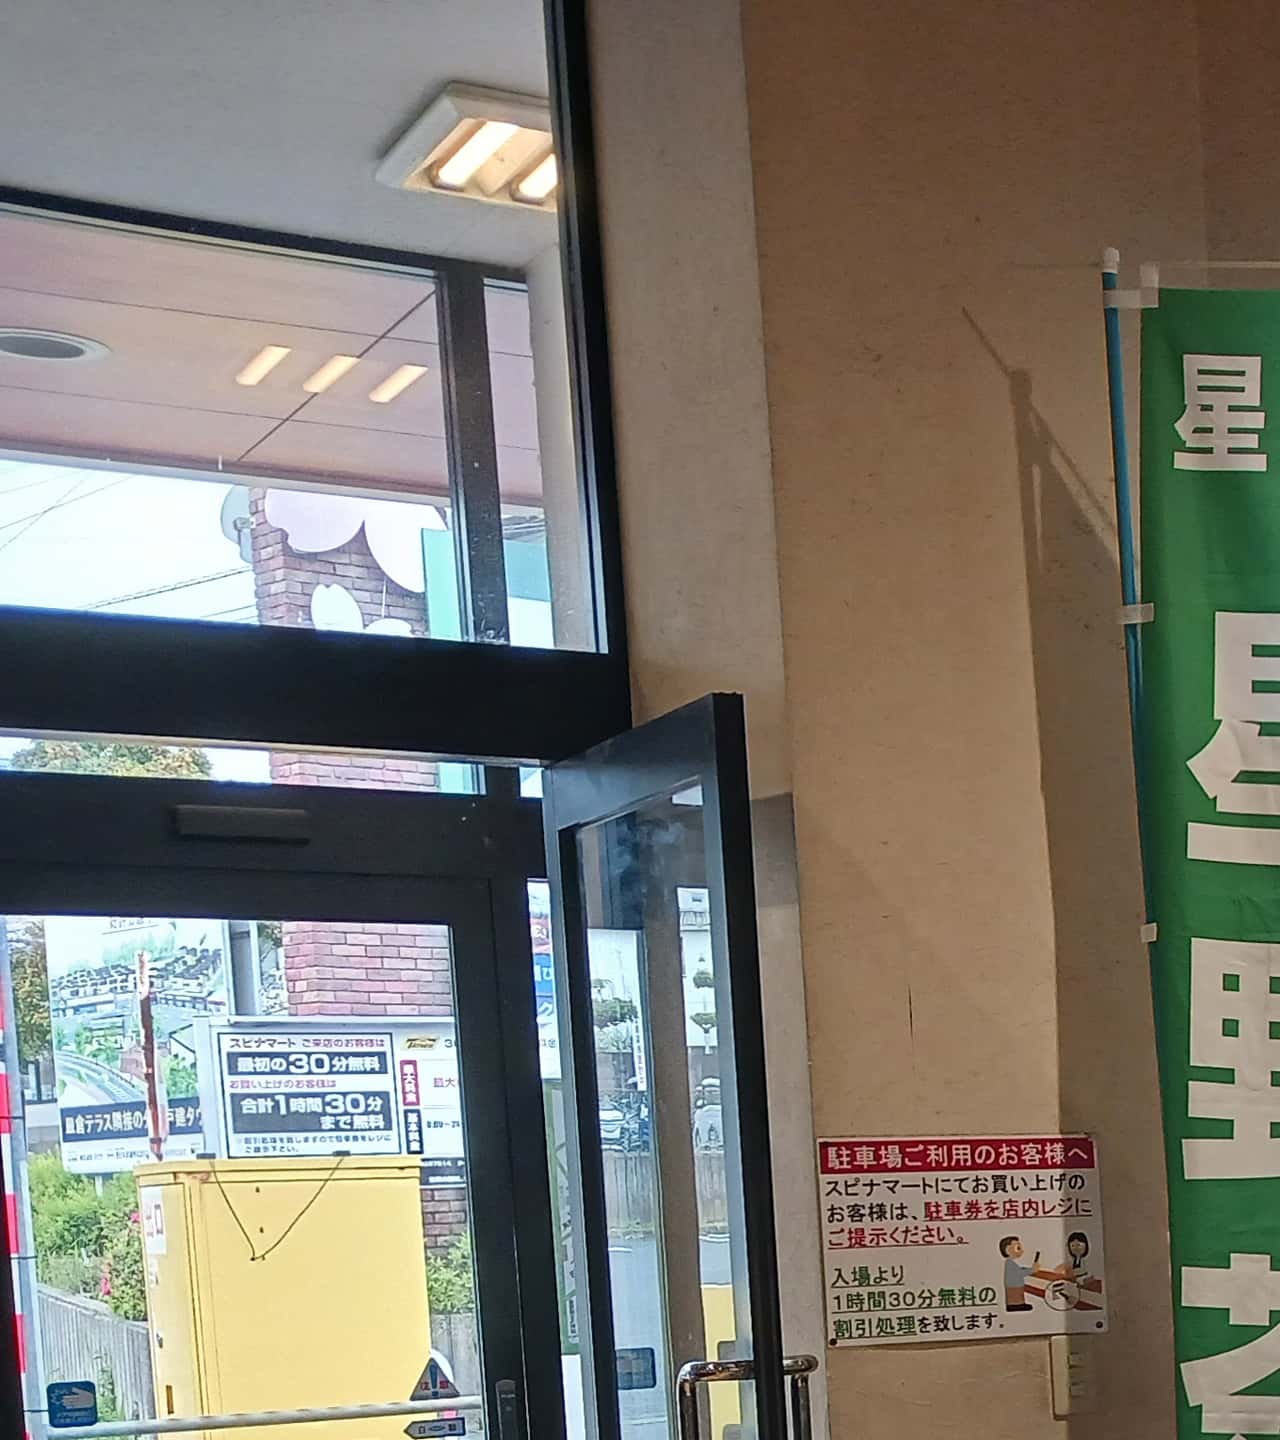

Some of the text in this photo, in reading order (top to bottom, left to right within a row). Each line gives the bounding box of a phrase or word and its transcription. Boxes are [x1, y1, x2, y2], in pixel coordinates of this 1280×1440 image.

[237, 1054, 380, 1073] 最初の30分無料
[240, 1094, 383, 1115] 合計1時間30分
[320, 1115, 385, 1130] まで無料
[827, 1145, 1088, 1170] 駐車場ご利用のお客様へ
[825, 1174, 1086, 1197] スピナマートにてお買い上げの
[826, 1198, 1092, 1223] お客様は、駐車券を店内レジに
[828, 1226, 967, 1247] ご提示ください。
[832, 1265, 904, 1286] 入場より
[833, 1287, 996, 1310] 1時間30分無料の
[833, 1312, 1005, 1338] 割引処理を致します。
